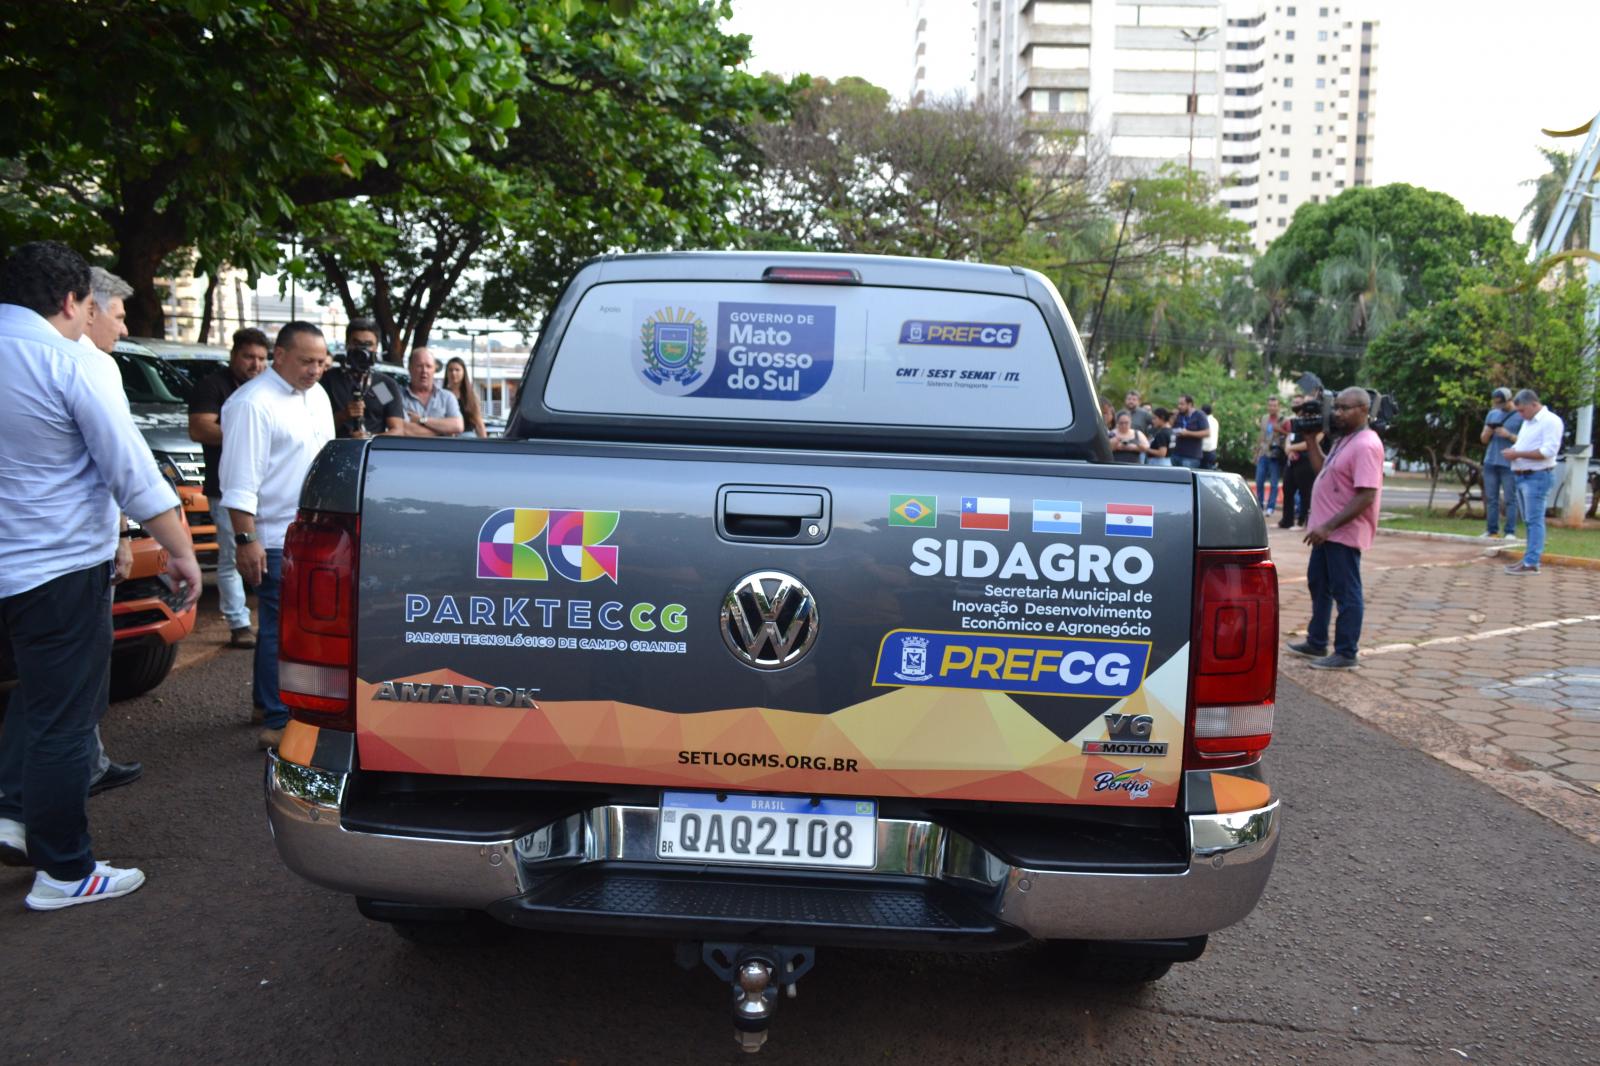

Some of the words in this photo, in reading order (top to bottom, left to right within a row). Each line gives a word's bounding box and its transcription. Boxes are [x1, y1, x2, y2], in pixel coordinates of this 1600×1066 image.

[730, 312, 794, 324] GOVERNO
[797, 314, 814, 325] DE
[729, 323, 792, 346] Mato
[927, 325, 1013, 344] PREFCG
[728, 346, 813, 369] Grosso
[727, 367, 760, 390] do
[763, 370, 800, 391] Sul
[896, 368, 919, 377] CNT
[927, 369, 956, 379] SEST
[960, 370, 996, 380] SENAT
[1004, 372, 1020, 382] ITL
[909, 538, 1154, 585] SIDAGRO
[984, 584, 1059, 600] Secretaria
[1061, 587, 1131, 604] Municipal
[1133, 589, 1153, 603] de
[405, 593, 688, 633] PARKTECCG
[952, 600, 1019, 617] Inovação
[1024, 602, 1152, 620] Desenvolvimento
[961, 616, 1043, 632] Econômico
[1045, 622, 1054, 632] e
[1057, 620, 1151, 638] Agronegócio
[405, 631, 460, 644] PARQUE
[461, 633, 556, 648] TECNOLÓGICO
[558, 637, 577, 649] DE
[579, 638, 628, 651] CAMPO
[630, 640, 687, 654] GRANDE
[939, 645, 1132, 687] PREFCG
[371, 681, 541, 710] AMAROK
[1103, 713, 1154, 740] V6
[678, 750, 859, 773] SETLOGMS.ORG.BR
[751, 799, 786, 811] BRASIL
[661, 840, 674, 853] BR
[679, 812, 854, 860] QAQ2I08
